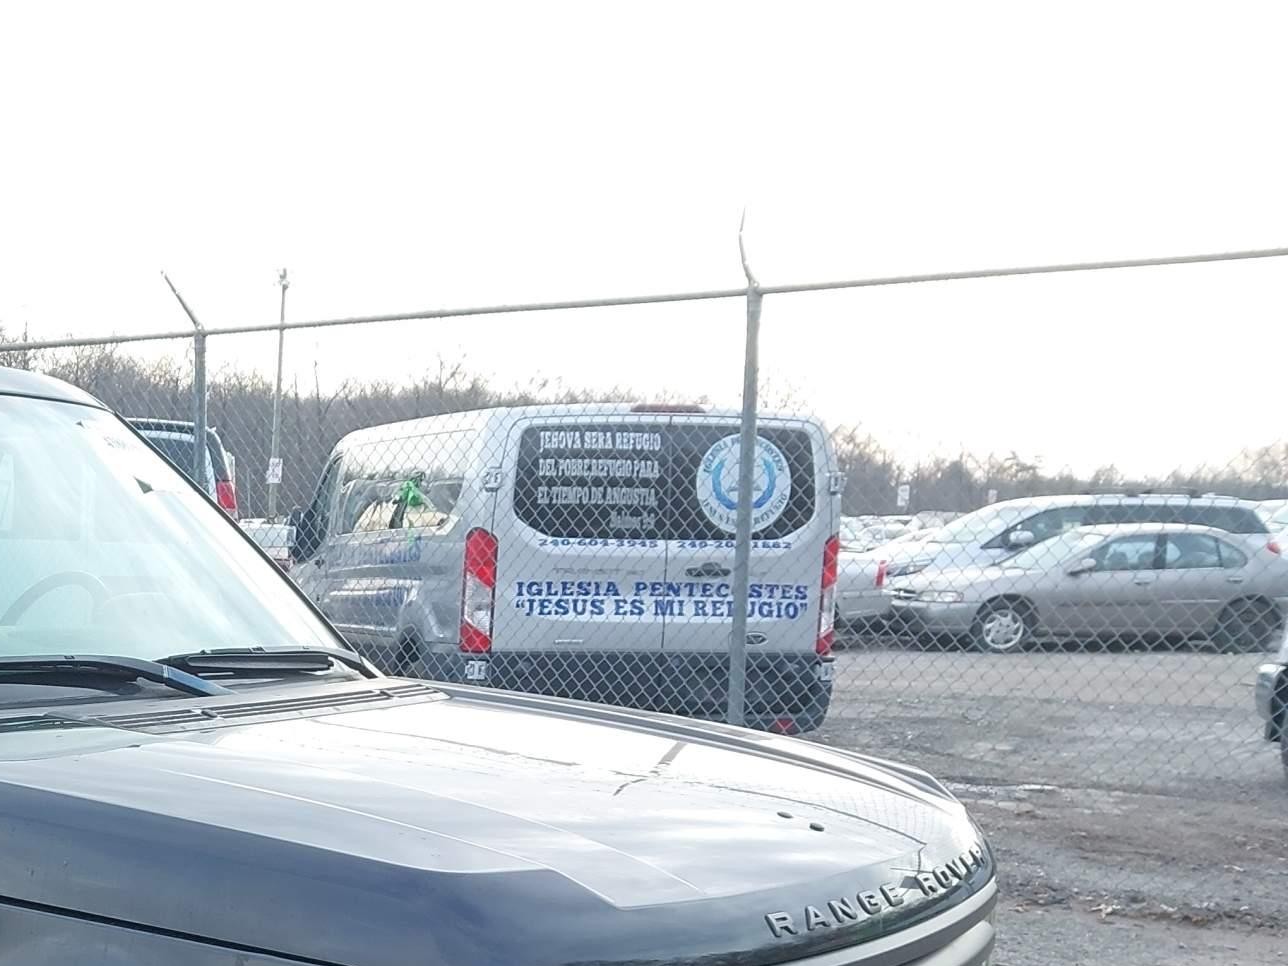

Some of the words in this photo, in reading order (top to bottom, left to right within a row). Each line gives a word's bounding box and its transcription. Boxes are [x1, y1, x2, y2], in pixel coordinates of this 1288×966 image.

[539, 430, 581, 453] JEHOVA
[583, 431, 613, 450] SERA
[615, 431, 662, 451] REFUGIO
[538, 458, 557, 476] DEL
[633, 460, 660, 479] PARA
[590, 486, 605, 505] DE
[516, 581, 621, 597] IGLESIA
[633, 581, 808, 600] PENTECSTES
[614, 599, 645, 616] ES
[653, 598, 684, 617] MI
[765, 883, 905, 938] RANGE
[915, 842, 985, 897] ROVER
